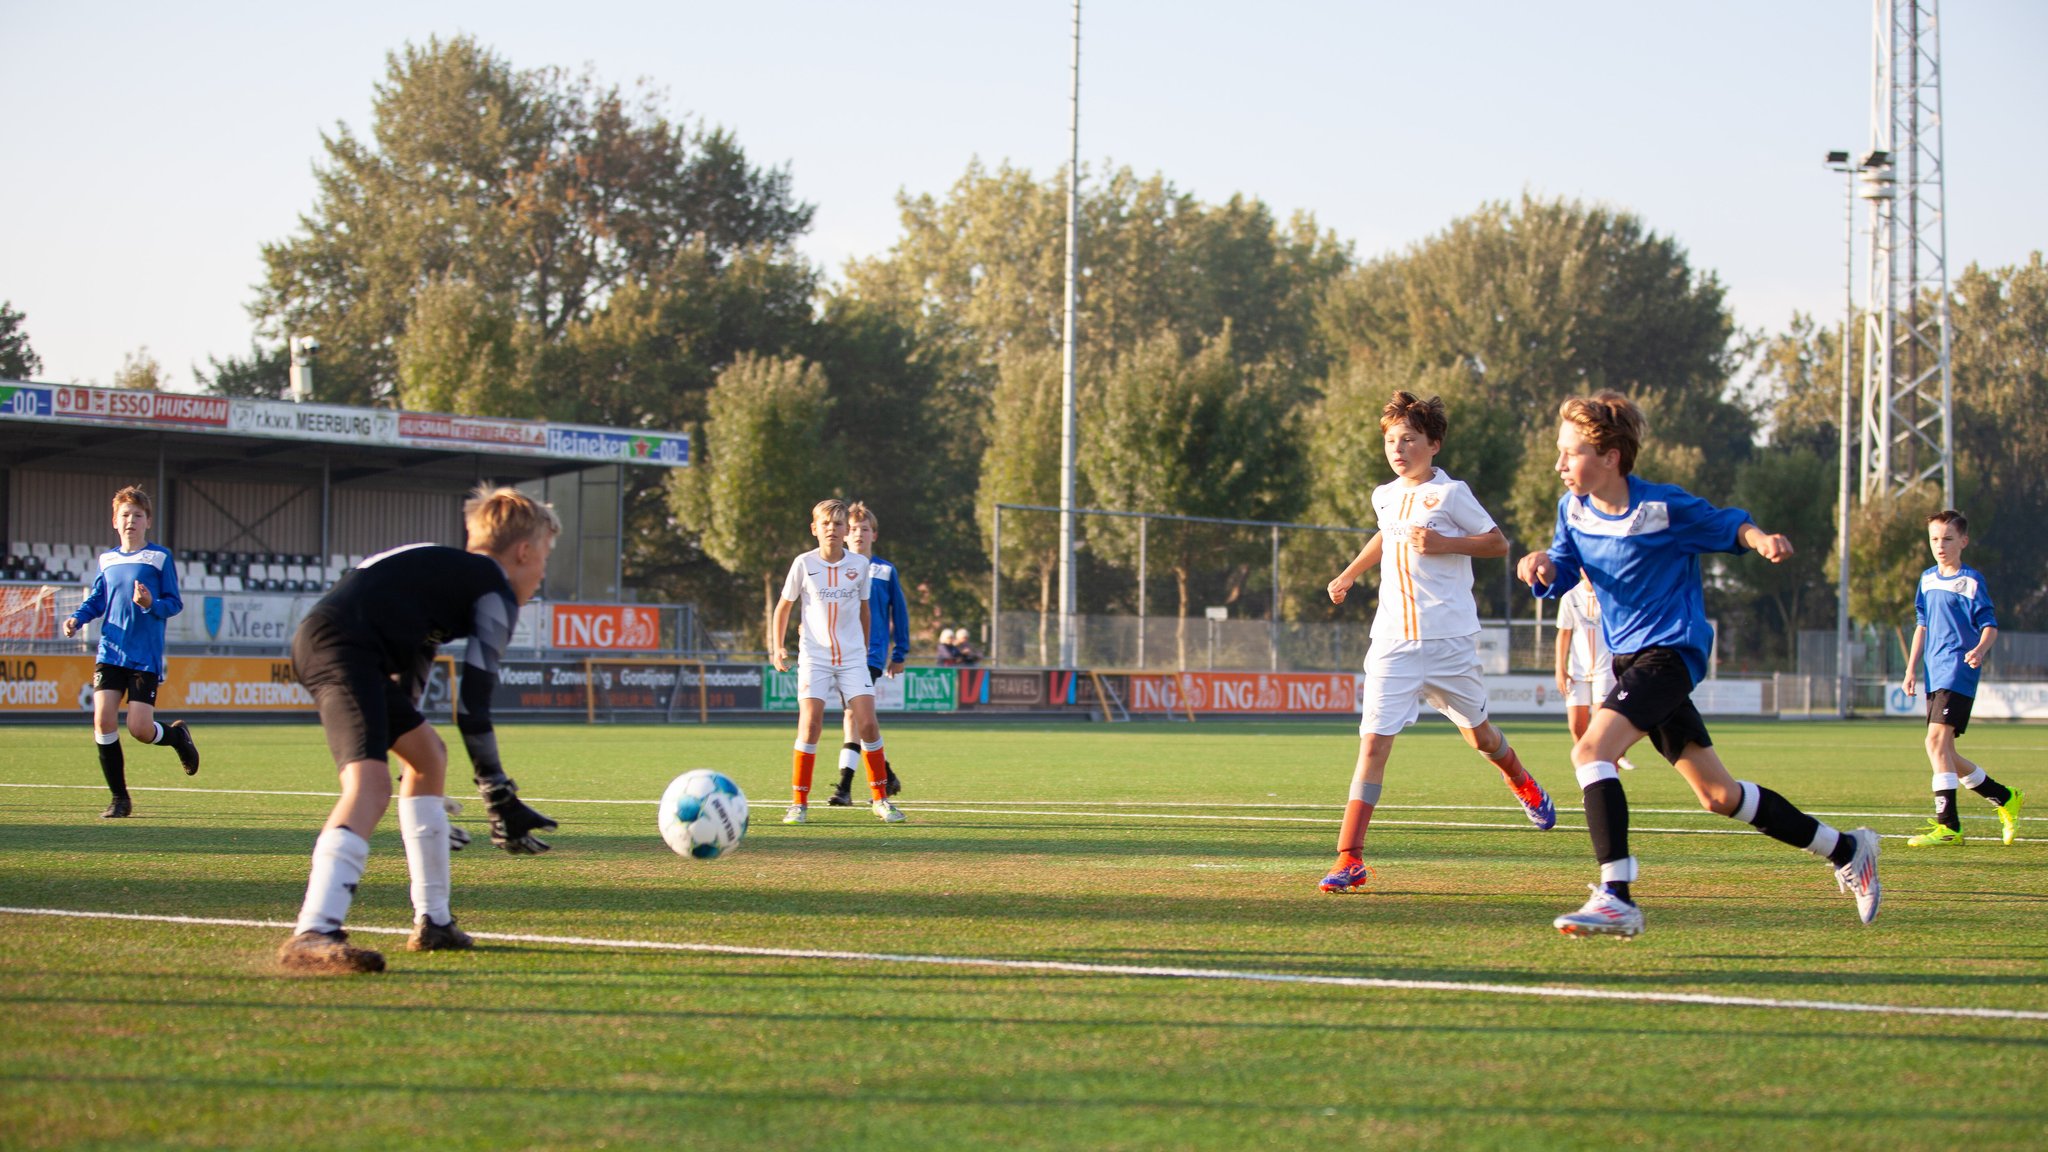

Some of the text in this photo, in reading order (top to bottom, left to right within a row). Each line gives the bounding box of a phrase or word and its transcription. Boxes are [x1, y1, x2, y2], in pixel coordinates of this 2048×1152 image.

[109, 393, 151, 415] ESSO
[154, 396, 227, 421] HUISMAN
[256, 410, 371, 436] r.k.v.v. MEERBURG
[548, 430, 631, 458] Heineken
[228, 611, 285, 638] Meer
[557, 612, 616, 648] ING
[185, 681, 232, 705] JUMBO
[991, 679, 1037, 697] TRAVEL
[1134, 678, 1178, 710] ING
[1213, 680, 1254, 710] ING
[1287, 681, 1326, 710] ING
